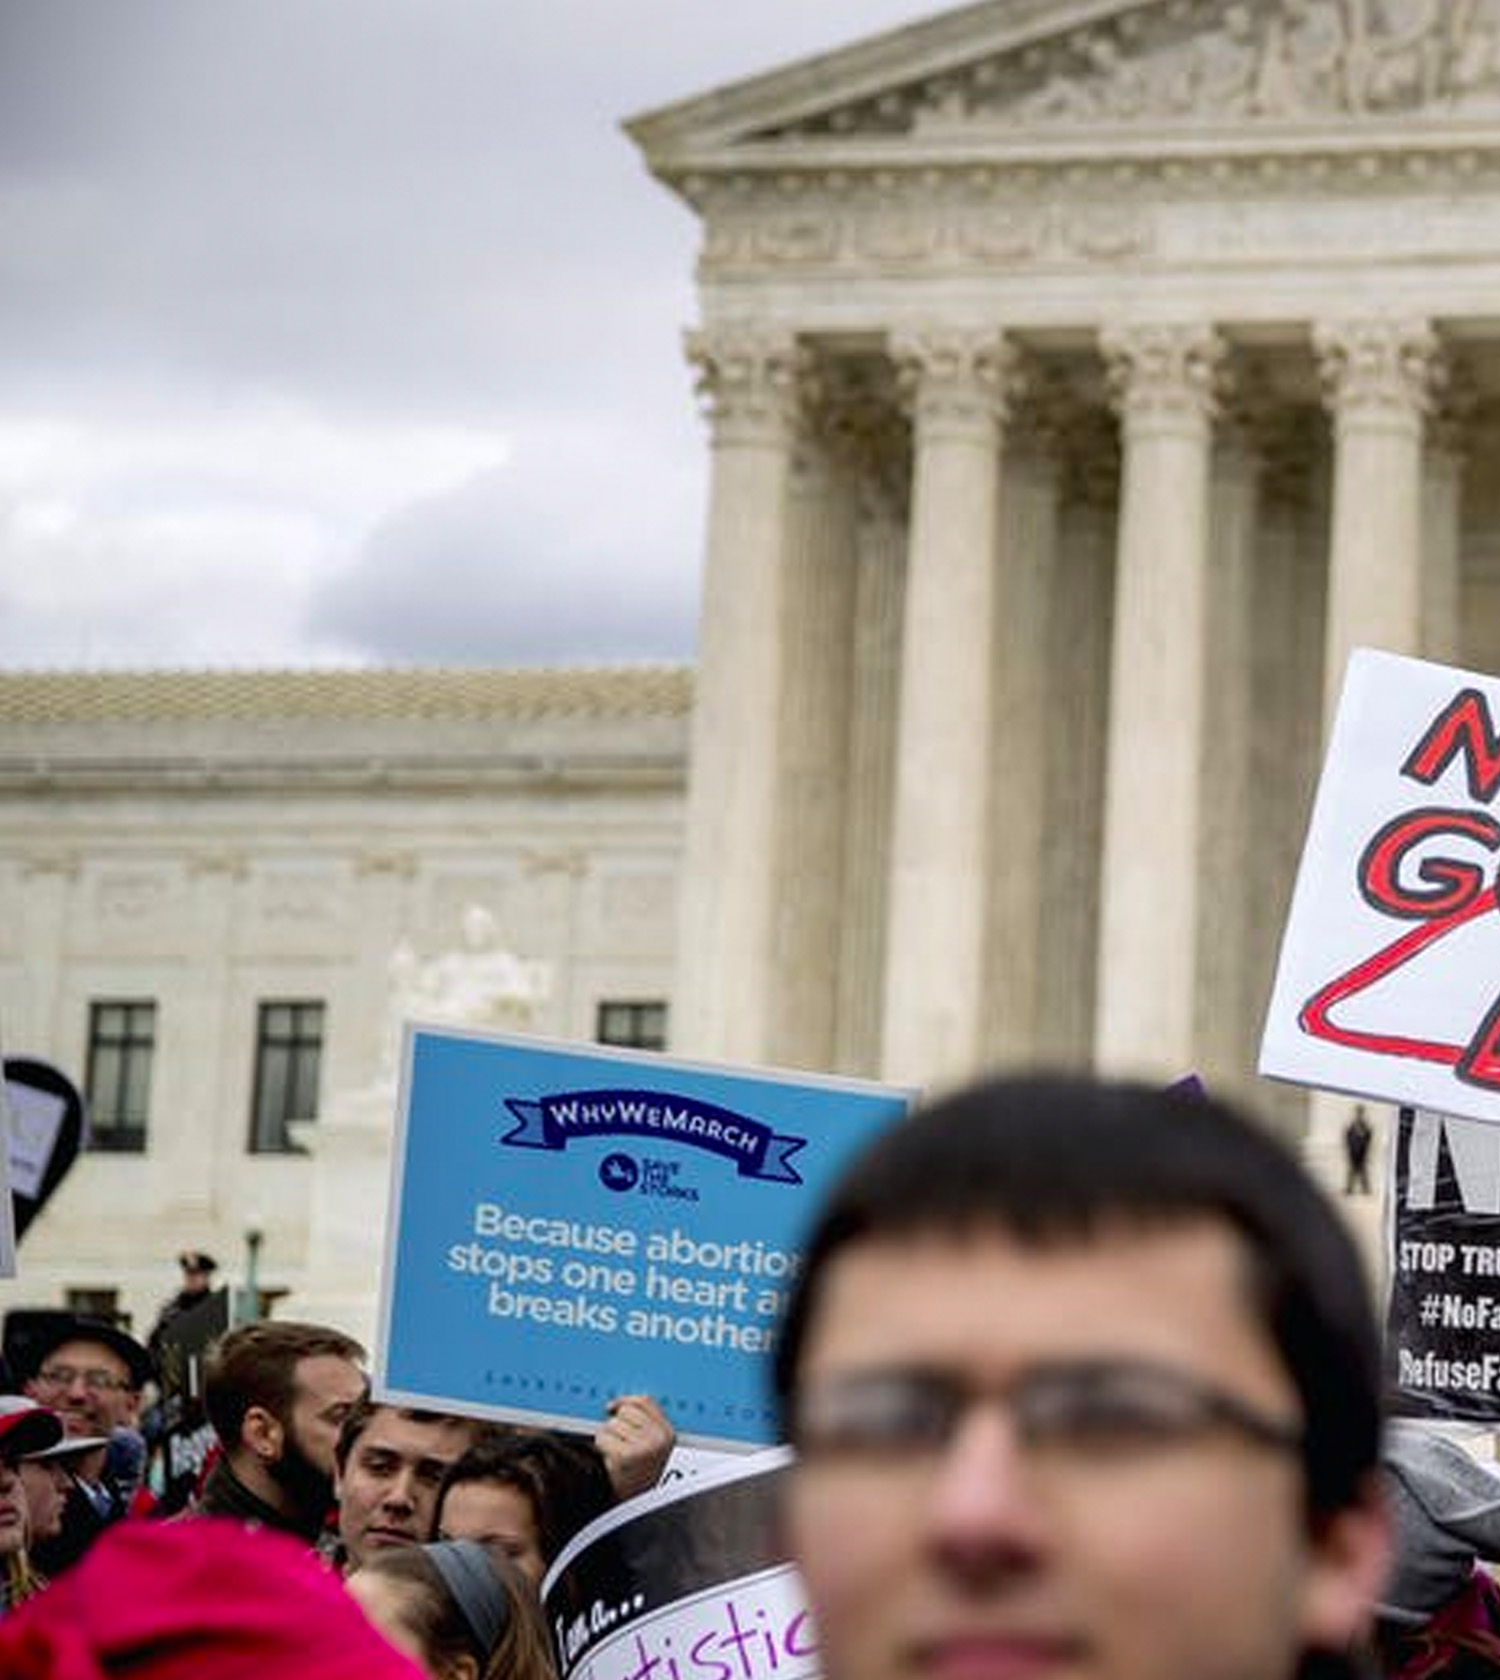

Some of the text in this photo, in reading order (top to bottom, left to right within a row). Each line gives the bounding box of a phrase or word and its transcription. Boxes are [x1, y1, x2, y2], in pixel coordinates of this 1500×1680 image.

[473, 1204, 637, 1256] Because
[448, 1241, 552, 1284] stops
[562, 1261, 635, 1294] one
[647, 1265, 748, 1312] heart
[488, 1283, 617, 1334] breaks
